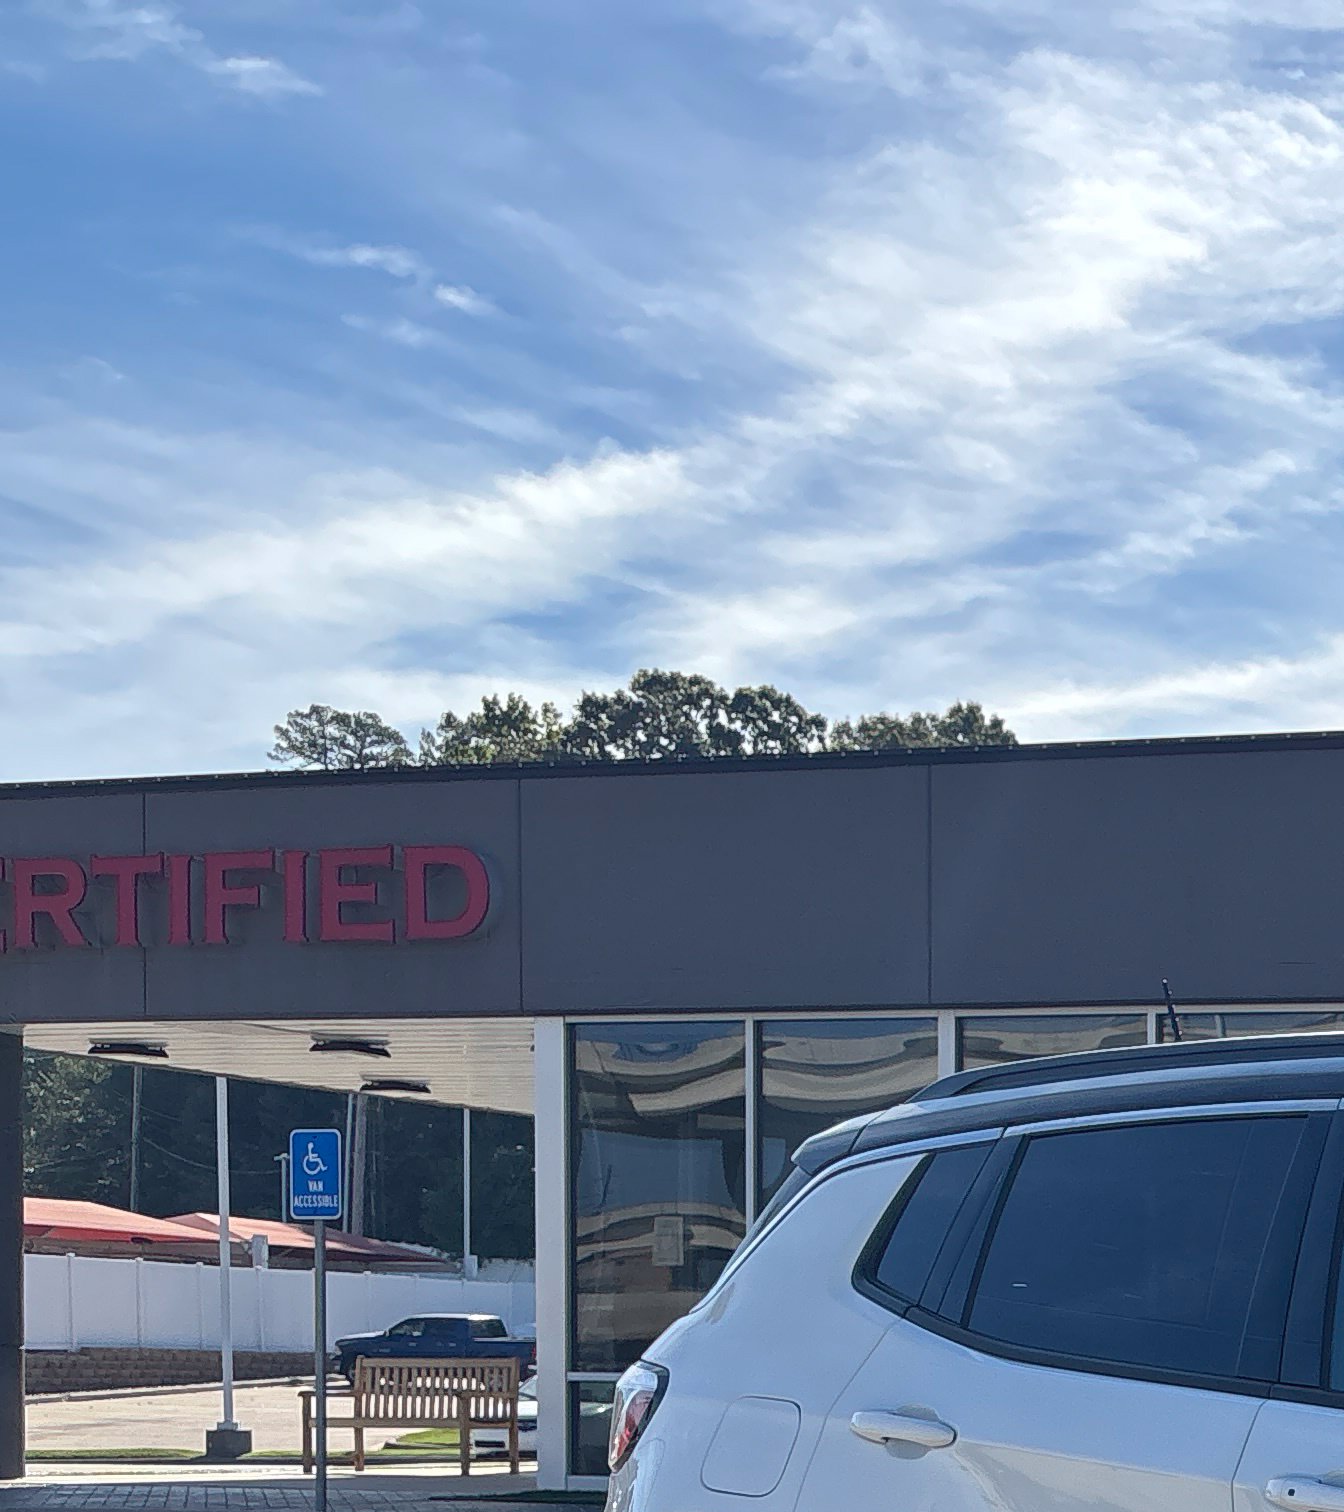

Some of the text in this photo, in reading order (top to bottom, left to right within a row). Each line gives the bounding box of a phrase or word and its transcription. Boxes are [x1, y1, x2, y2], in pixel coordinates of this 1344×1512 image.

[0, 844, 490, 953] RTIFIED
[307, 1180, 324, 1192] VAN
[293, 1194, 339, 1207] ACCESSIBLE
